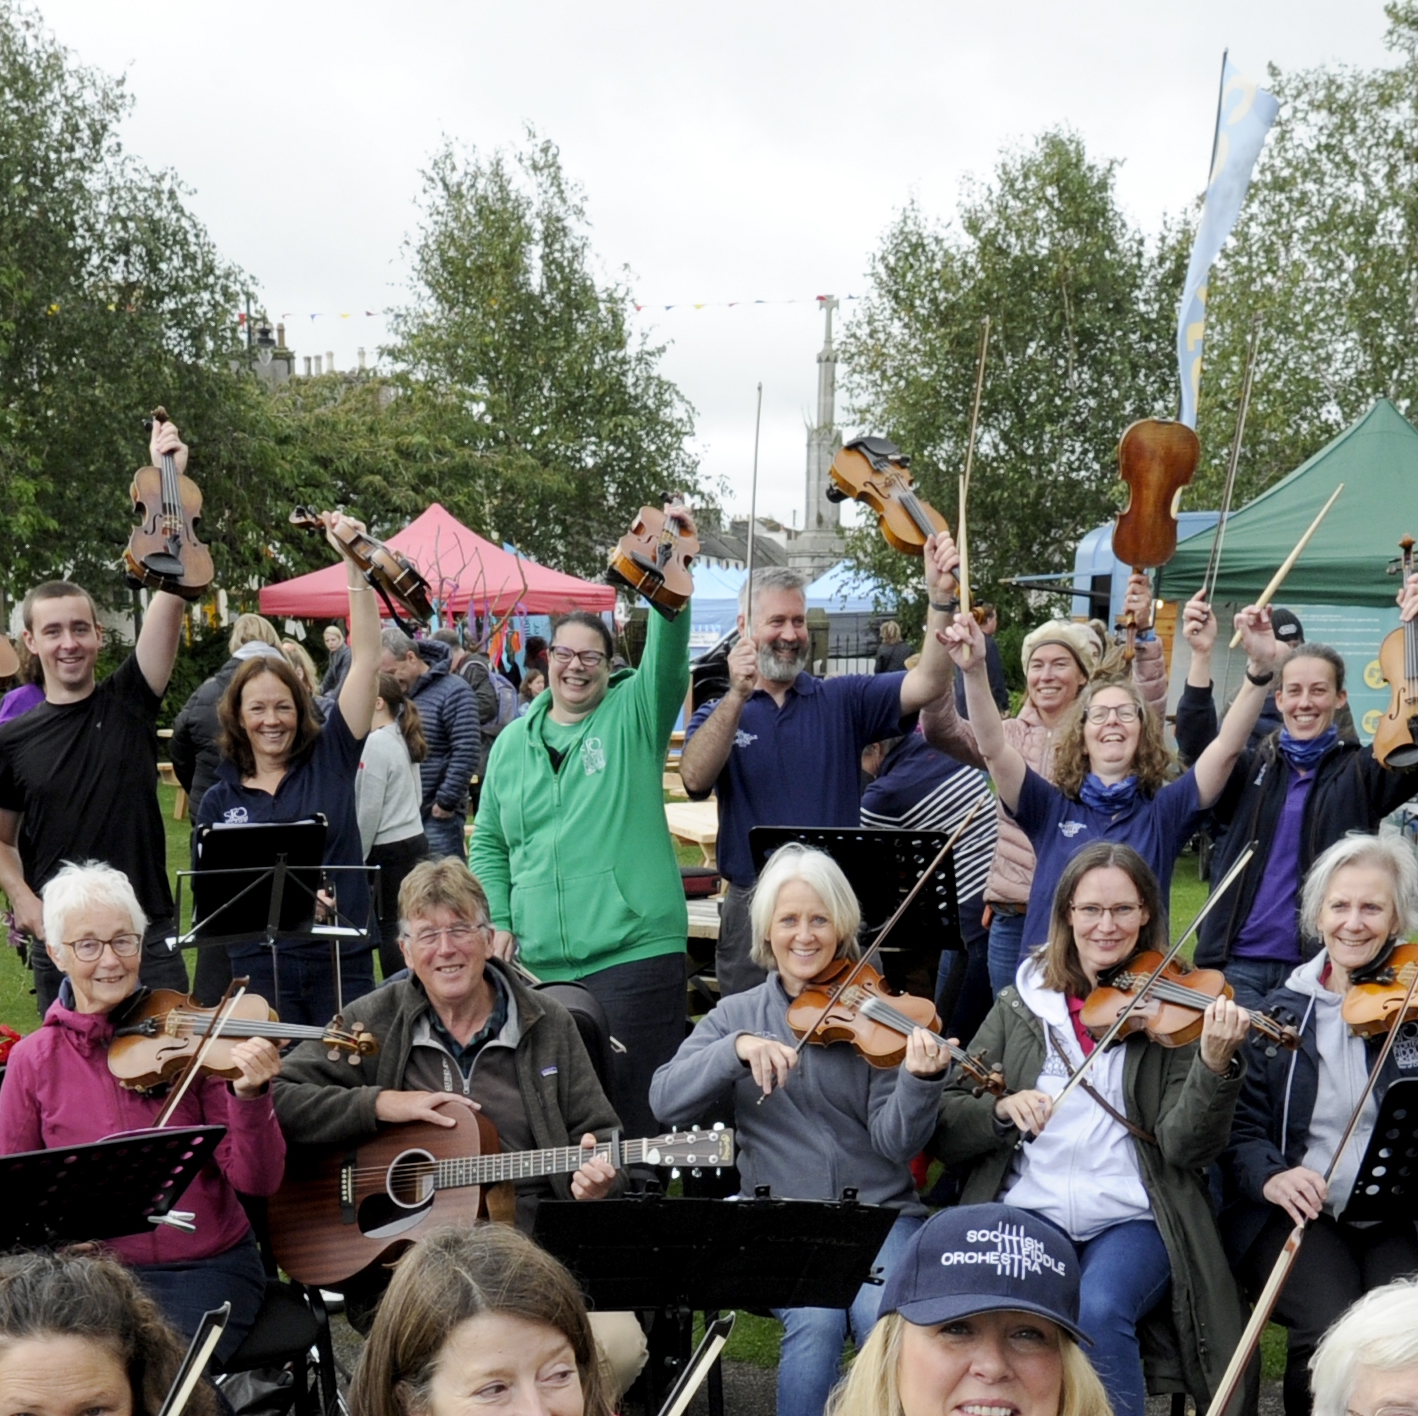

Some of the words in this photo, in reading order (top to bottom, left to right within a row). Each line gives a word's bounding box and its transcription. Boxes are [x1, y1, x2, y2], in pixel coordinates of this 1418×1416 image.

[966, 1225, 1045, 1254] SCOTTISH
[941, 1250, 1043, 1277] ORCHESTRA
[1022, 1247, 1067, 1277] FIDDLE
